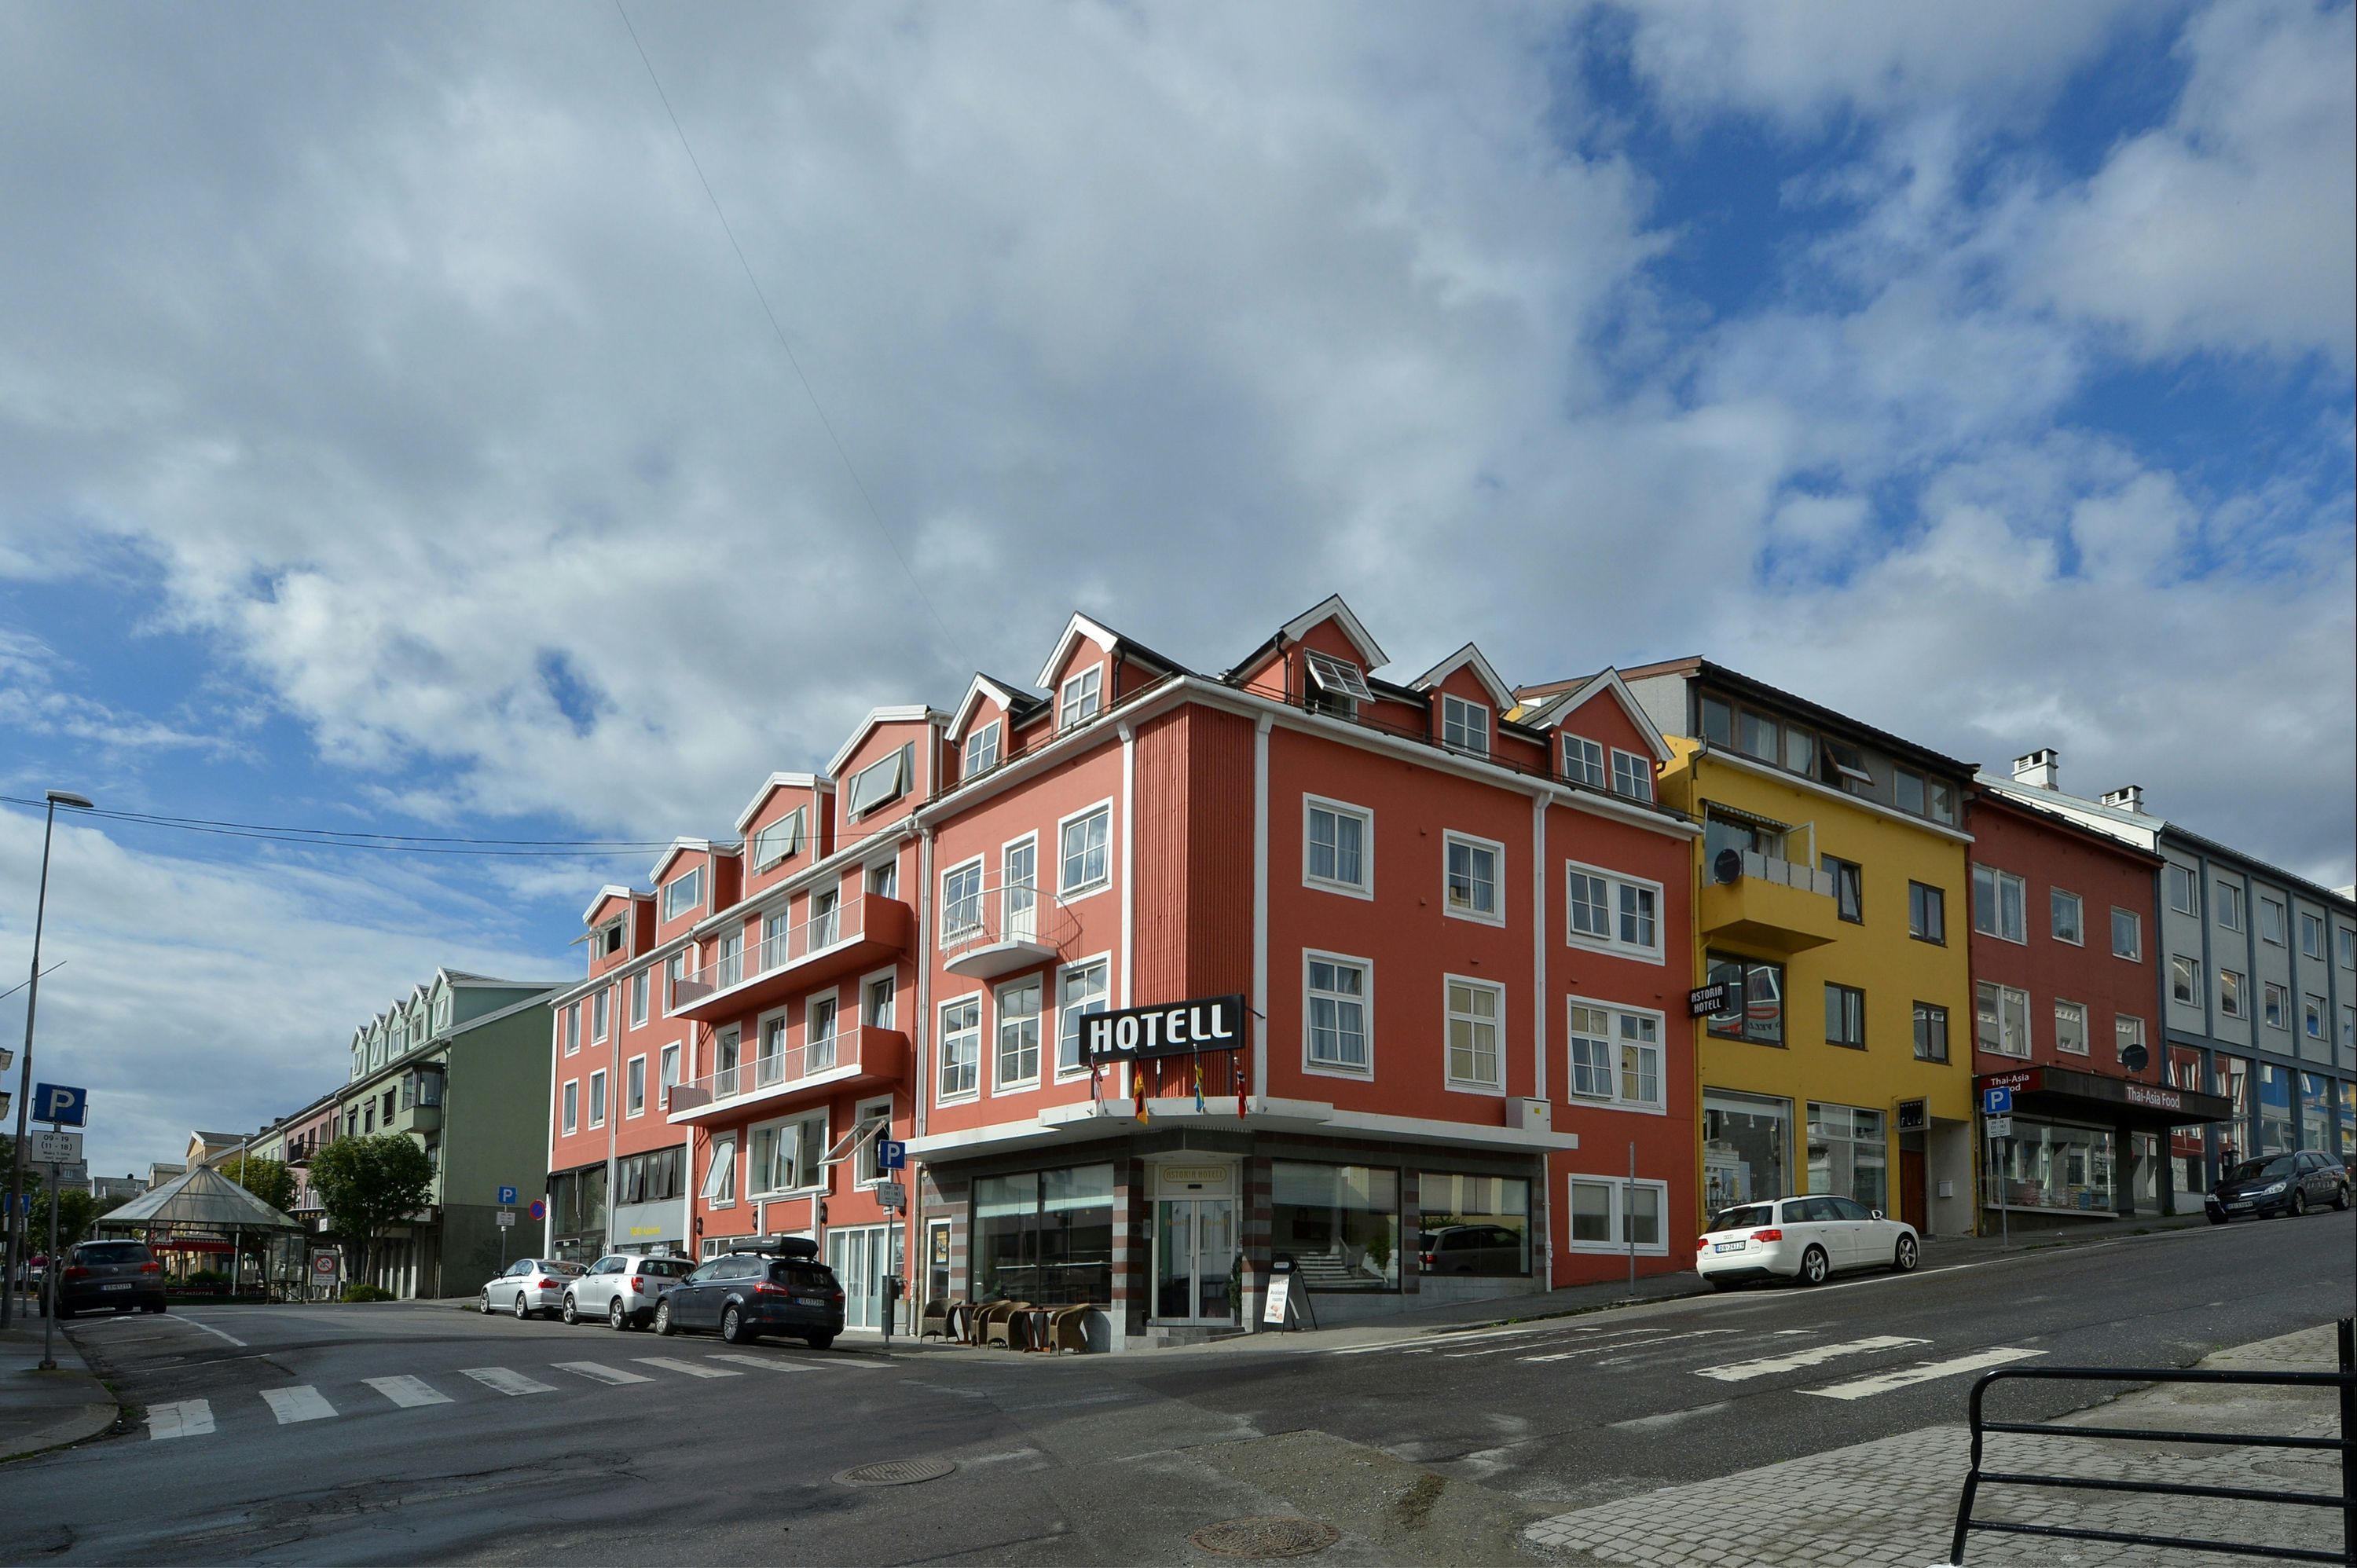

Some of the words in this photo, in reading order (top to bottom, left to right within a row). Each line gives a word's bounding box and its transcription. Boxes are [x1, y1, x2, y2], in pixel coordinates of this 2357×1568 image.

[1692, 985, 1723, 1003] ASTORIA
[1694, 998, 1721, 1013] HOTELL
[1091, 1004, 1233, 1053] HOTELL
[1990, 1074, 2029, 1086] Thai-Asia
[49, 1089, 75, 1117] P
[1991, 1091, 2003, 1109] P
[2127, 1086, 2161, 1105] Thai-Asia
[2161, 1093, 2180, 1108] Food
[887, 1143, 900, 1165] P
[1198, 1170, 1223, 1178] HOTELL
[503, 1189, 513, 1202] P
